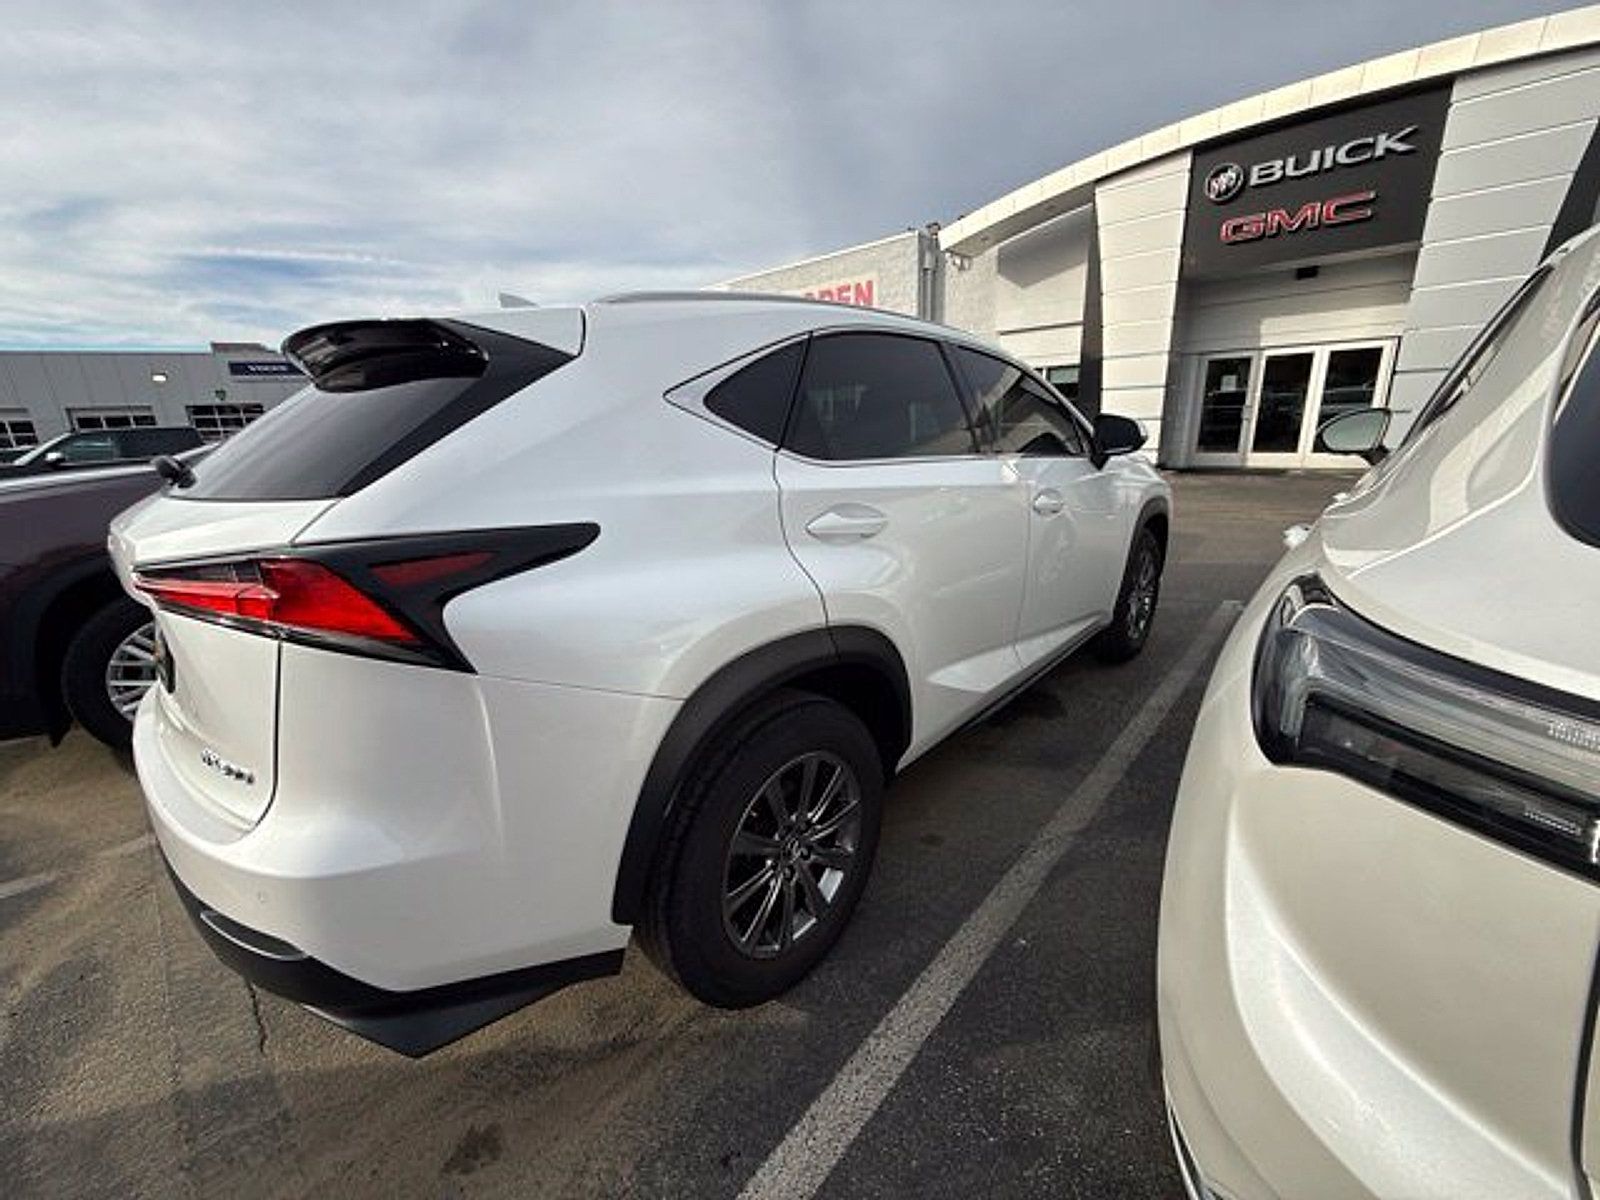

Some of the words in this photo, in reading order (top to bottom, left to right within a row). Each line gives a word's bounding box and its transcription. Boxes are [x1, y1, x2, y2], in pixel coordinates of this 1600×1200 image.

[1250, 125, 1418, 186] BUICK
[1220, 190, 1376, 243] GMC
[804, 280, 874, 305] PEN
